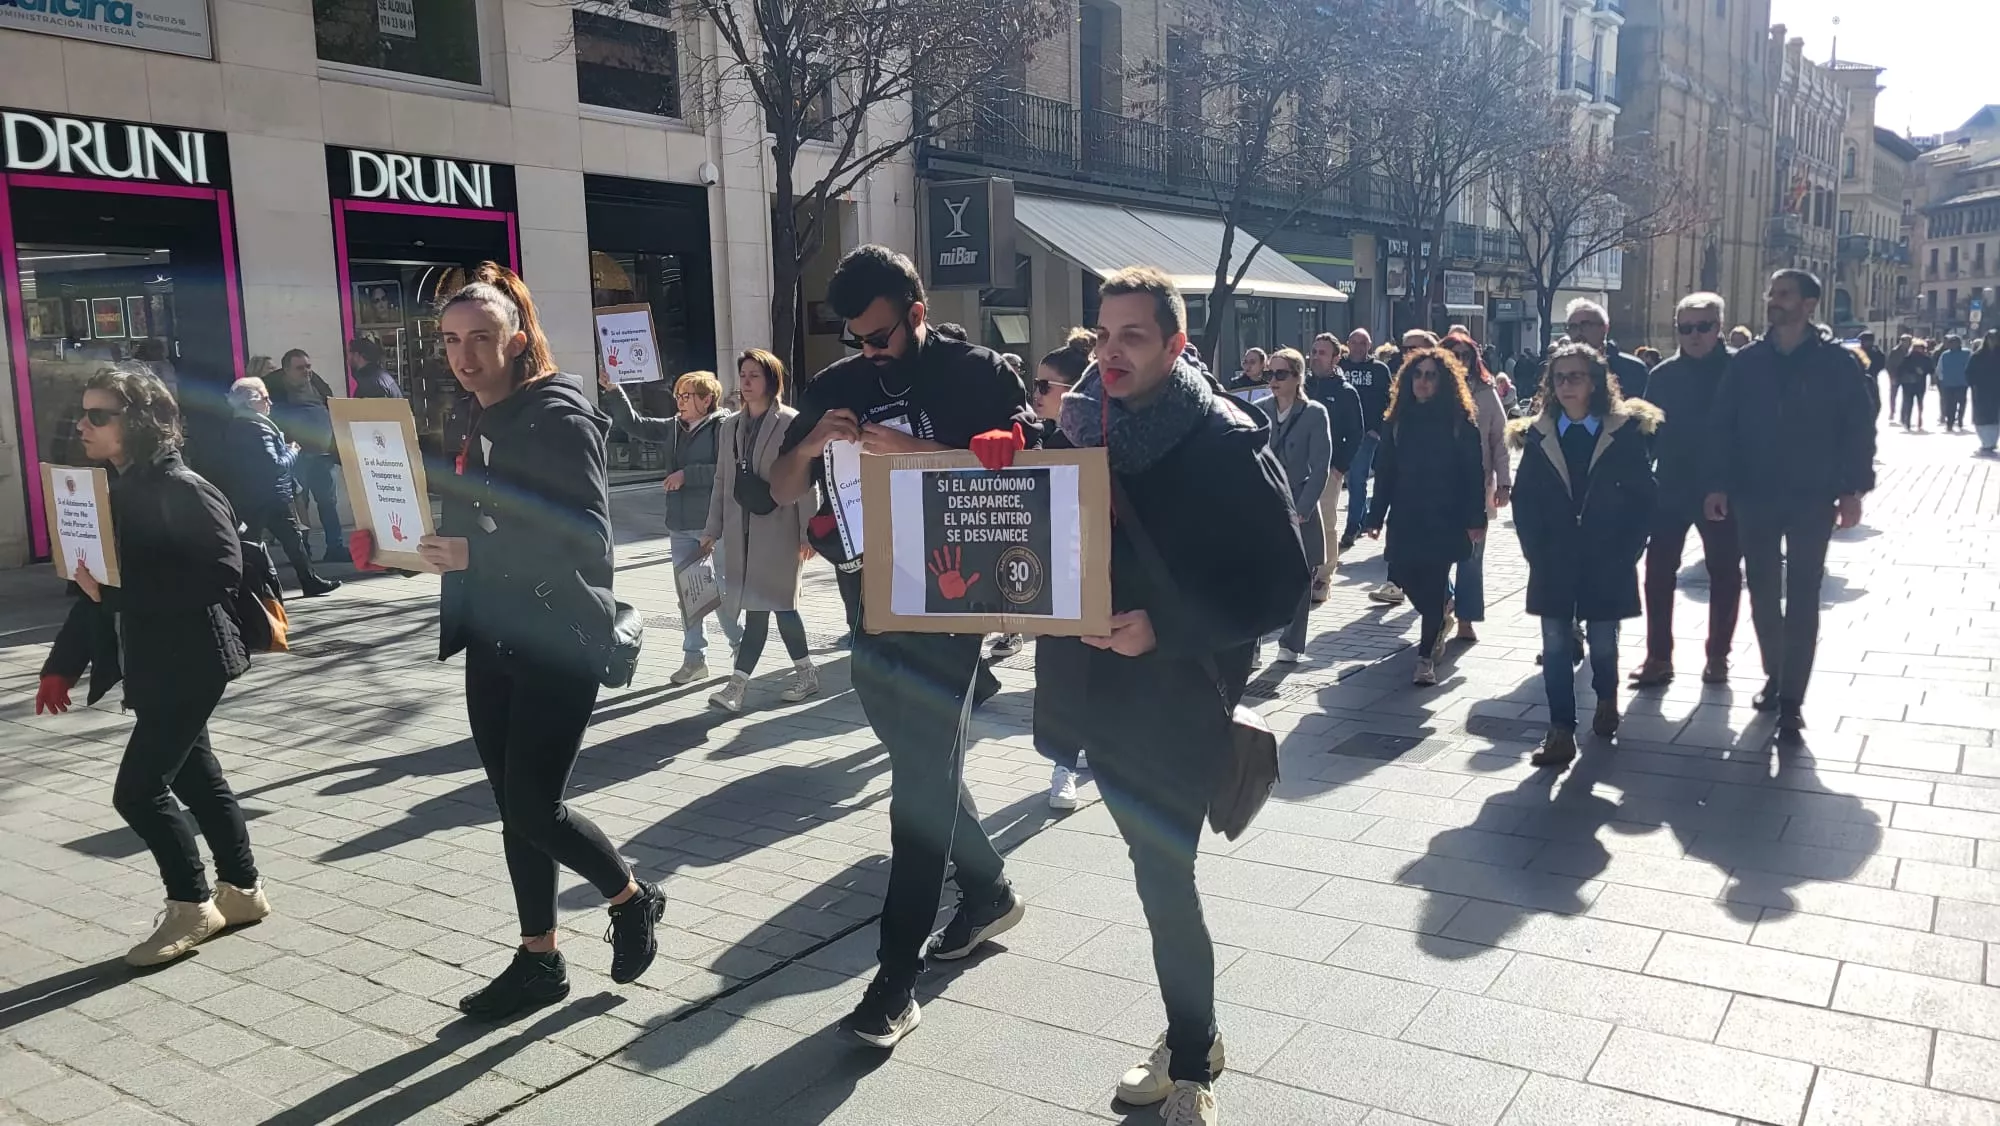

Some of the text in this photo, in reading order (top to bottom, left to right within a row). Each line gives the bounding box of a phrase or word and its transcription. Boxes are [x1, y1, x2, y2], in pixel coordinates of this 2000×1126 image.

[87, 23, 137, 38] INTEGRAL
[1, 111, 211, 185] DRUNI
[348, 149, 495, 209] DRUNI
[939, 246, 979, 266] miBar
[633, 348, 643, 357] 30
[937, 475, 1036, 492] SI EL AUTÓNOMO
[948, 494, 1024, 510] DESAPARECE,
[944, 510, 1032, 526] EL PAÍS ENTERO
[946, 528, 1029, 543] SE DESVANECE
[1008, 561, 1029, 582] 30
[1015, 581, 1022, 592] N
